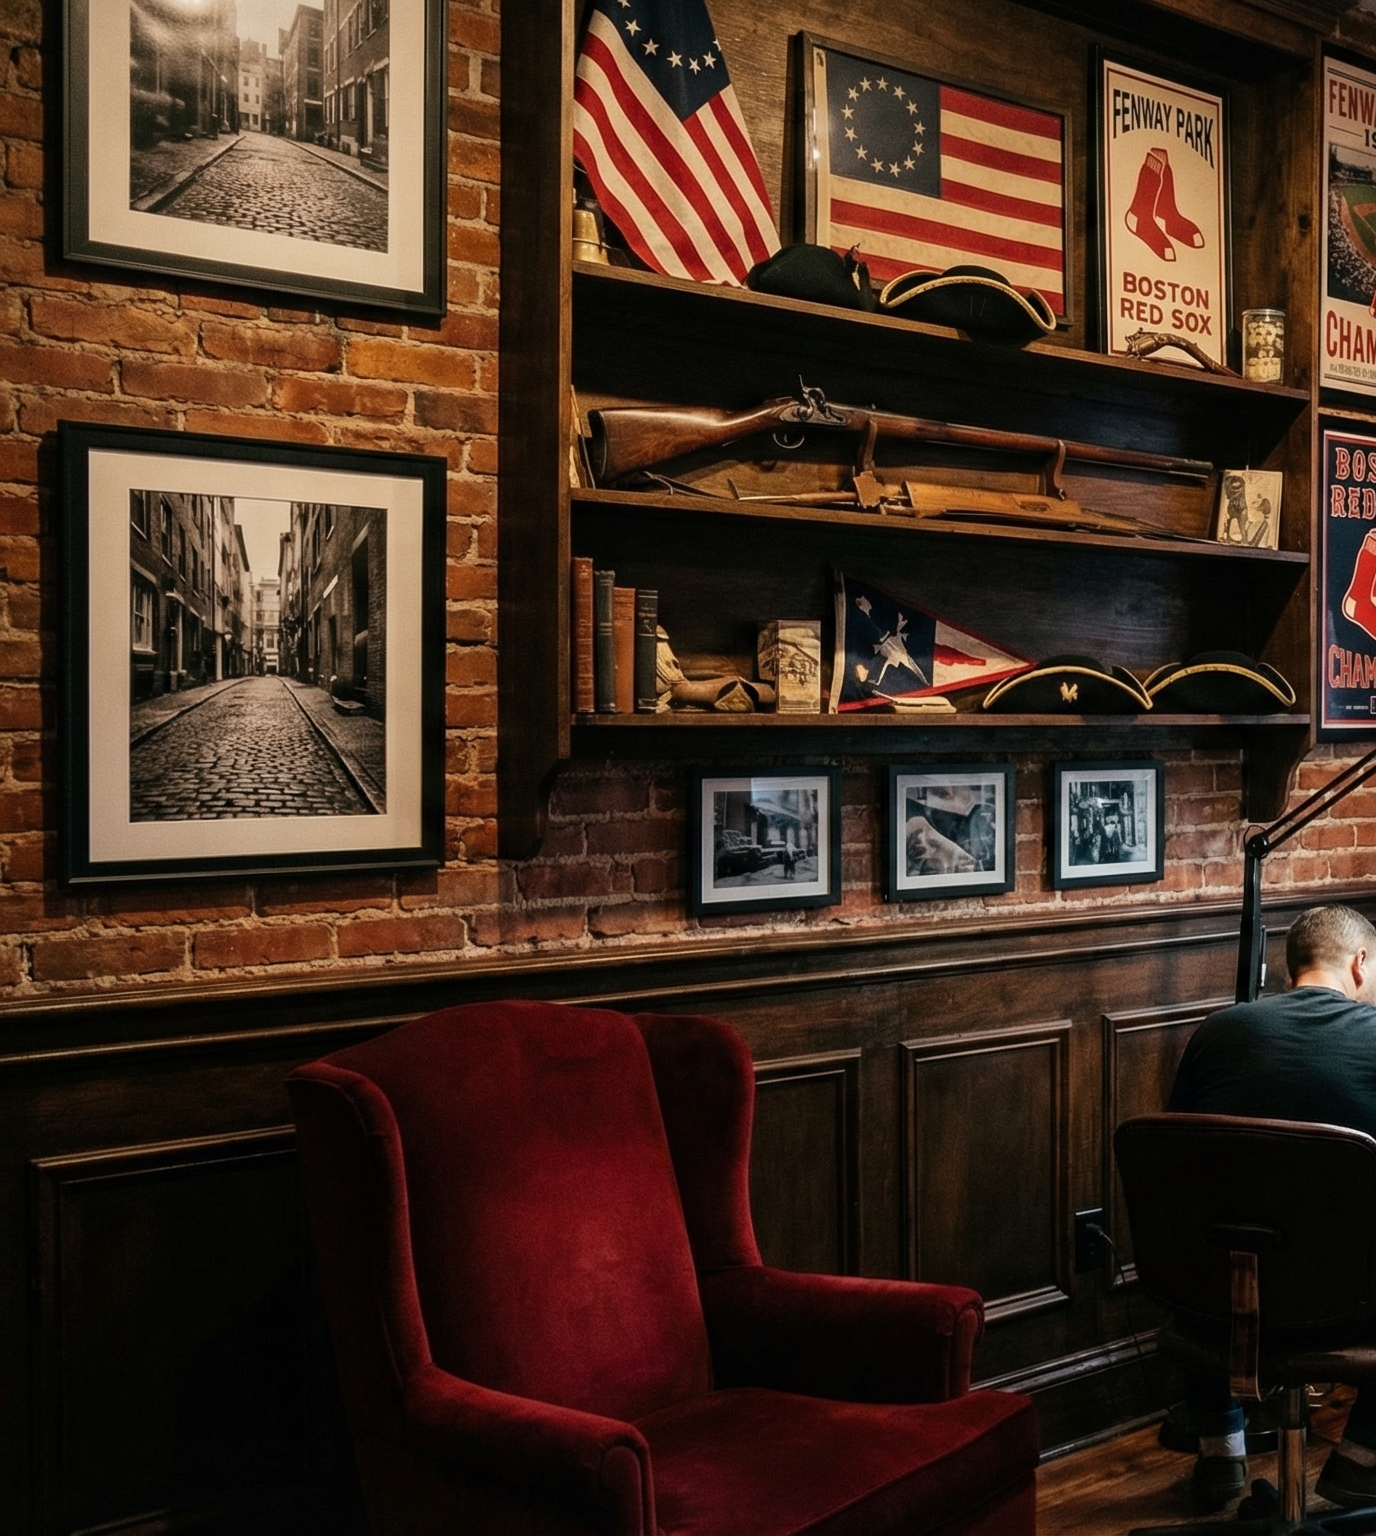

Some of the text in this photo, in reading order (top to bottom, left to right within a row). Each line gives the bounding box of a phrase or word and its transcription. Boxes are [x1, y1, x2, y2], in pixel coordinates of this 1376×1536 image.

[1113, 88, 1215, 169] FENWAY PARK
[1122, 271, 1209, 310] BOSTON
[1120, 297, 1212, 336] RED SOX
[1331, 485, 1376, 520] RED
